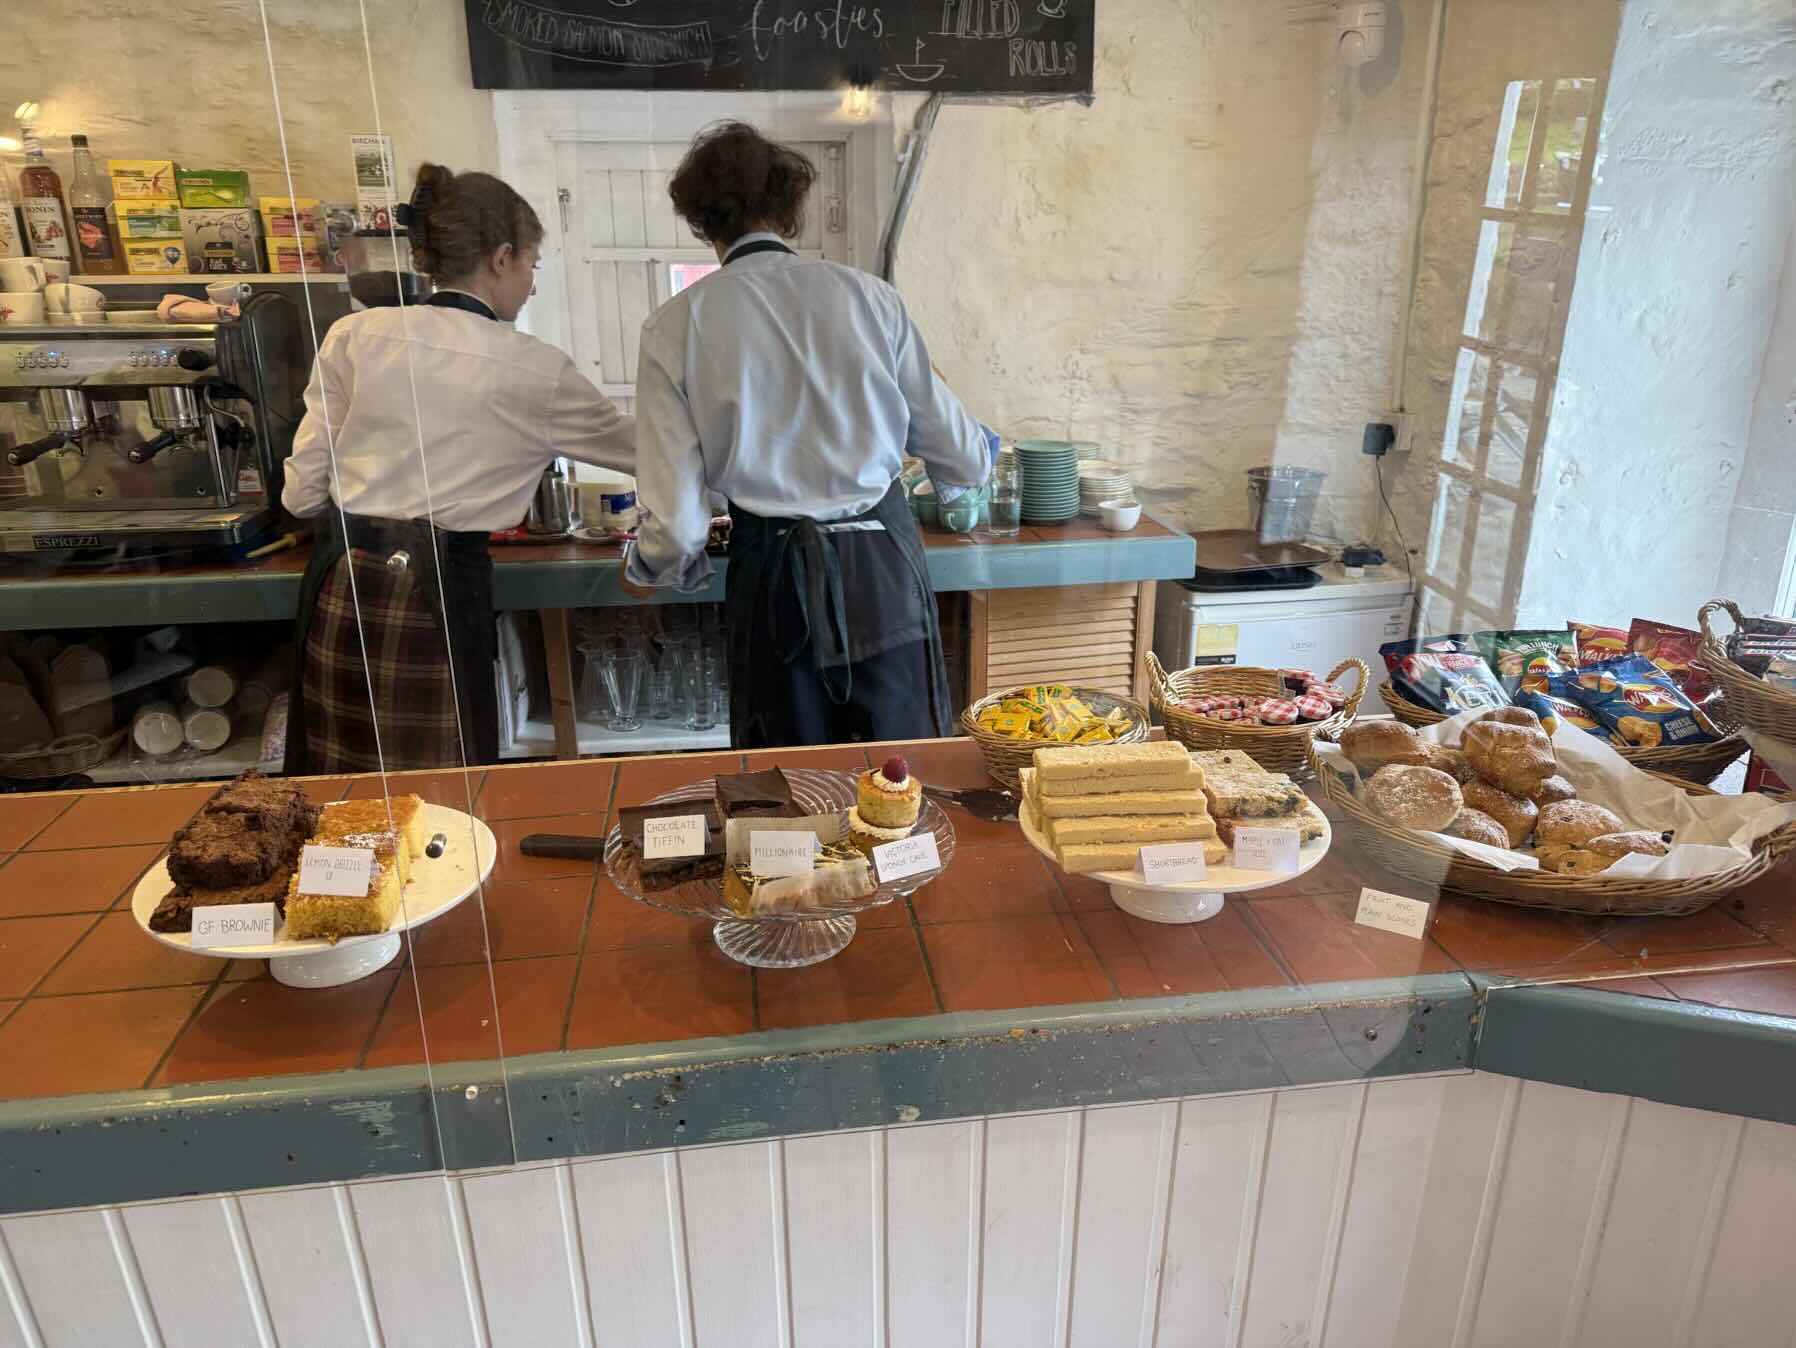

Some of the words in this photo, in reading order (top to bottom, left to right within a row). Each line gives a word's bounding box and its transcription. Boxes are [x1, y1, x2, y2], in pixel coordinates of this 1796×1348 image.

[1008, 38, 1078, 77] ROLLS
[646, 819, 697, 834] CHOCOLATE
[653, 836, 686, 848] TIFFIN
[199, 920, 215, 935] GF
[221, 917, 271, 935] BROWNIE
